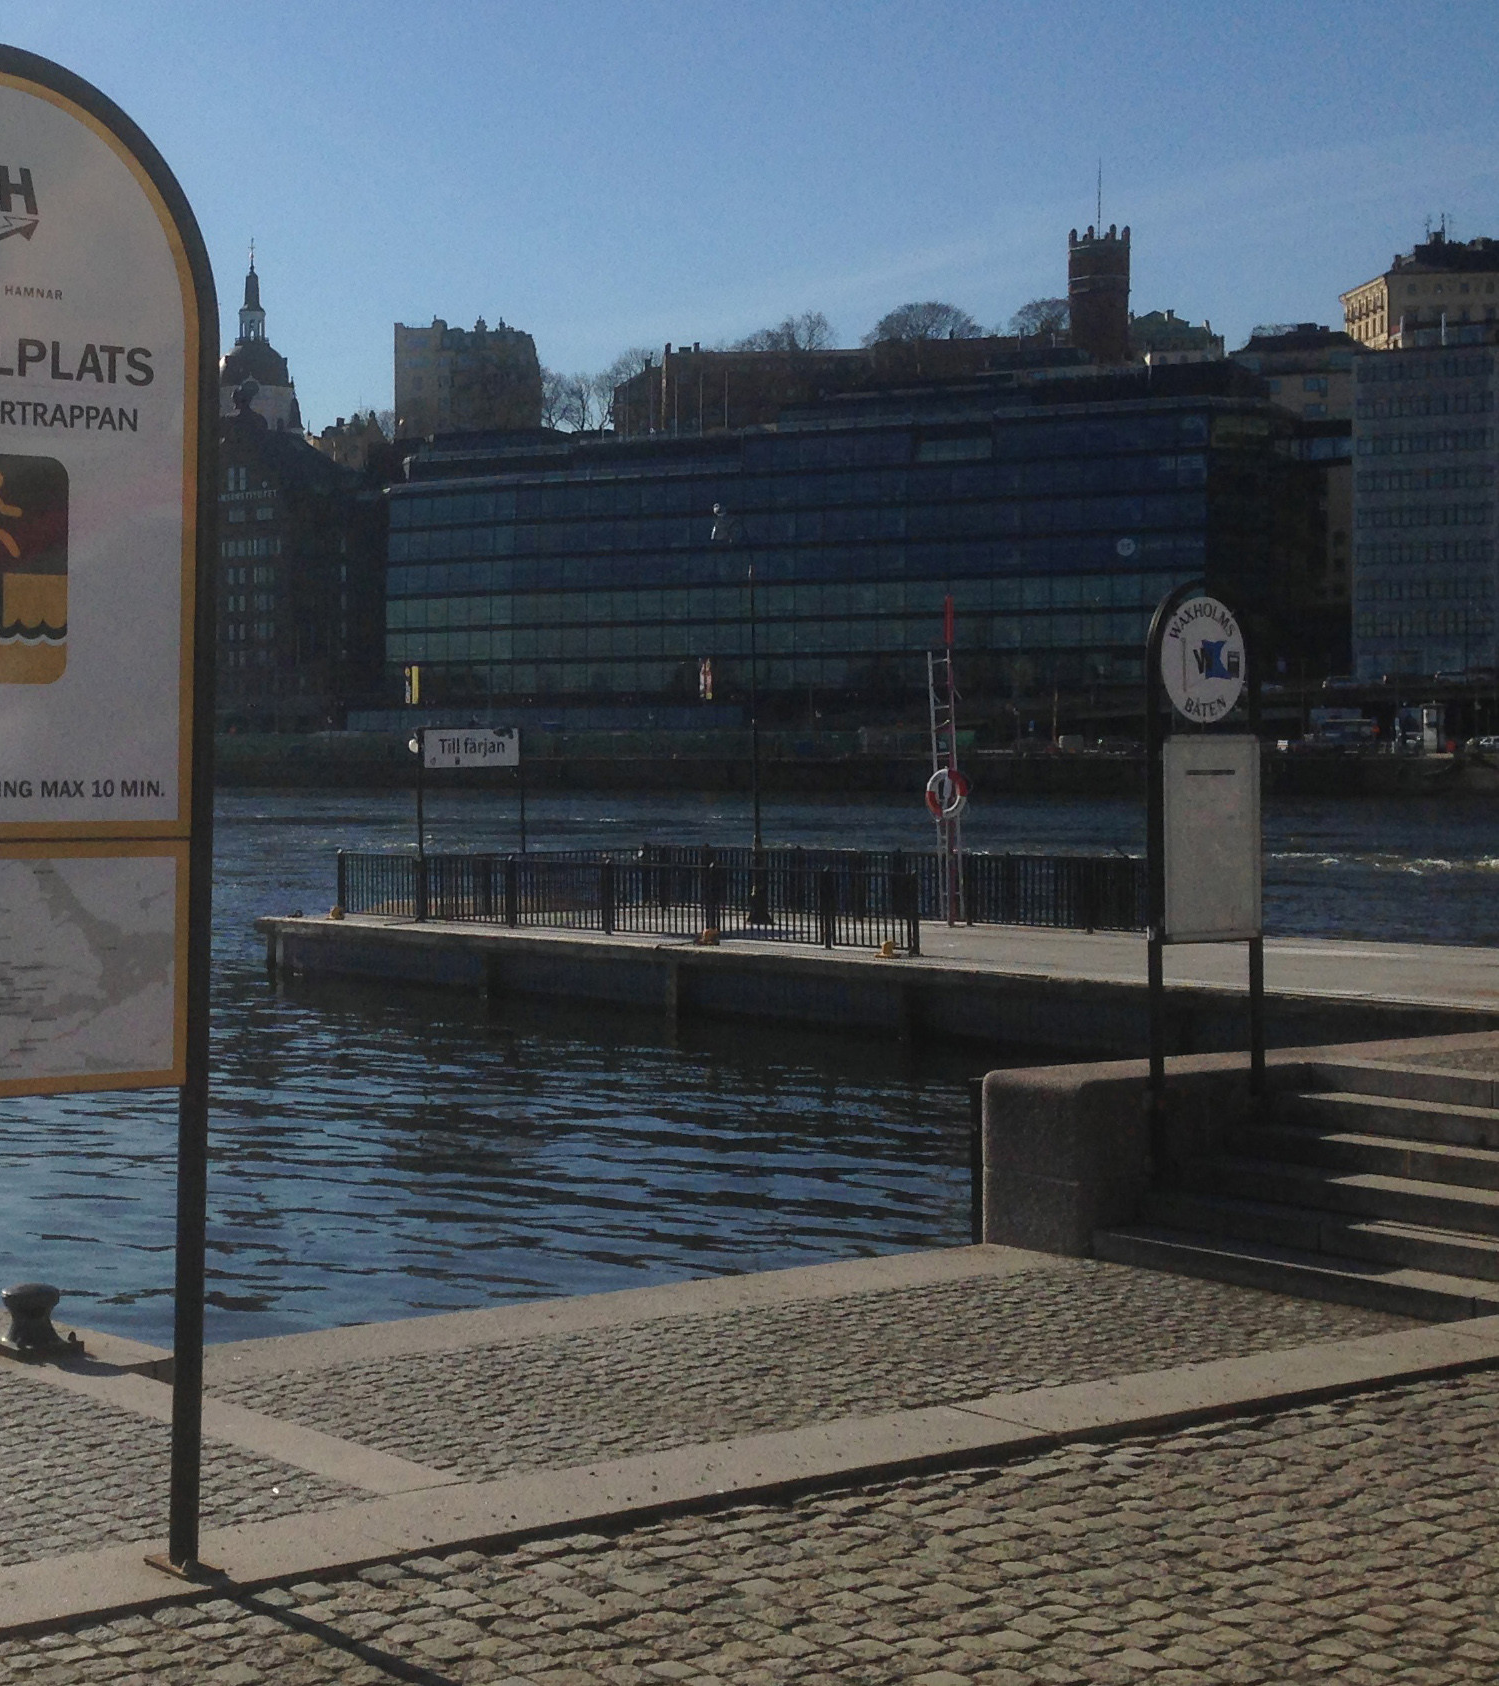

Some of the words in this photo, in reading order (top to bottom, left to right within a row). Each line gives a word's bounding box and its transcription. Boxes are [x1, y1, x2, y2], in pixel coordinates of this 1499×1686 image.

[4, 285, 63, 301] HAMNAR
[1169, 603, 1233, 639] WAXHOLMS
[1185, 697, 1227, 717] BÅTEN
[439, 738, 460, 754] Till
[464, 737, 505, 757] färjan
[40, 780, 85, 798] MAX
[91, 779, 115, 798] 10
[120, 780, 165, 797] MIN.
